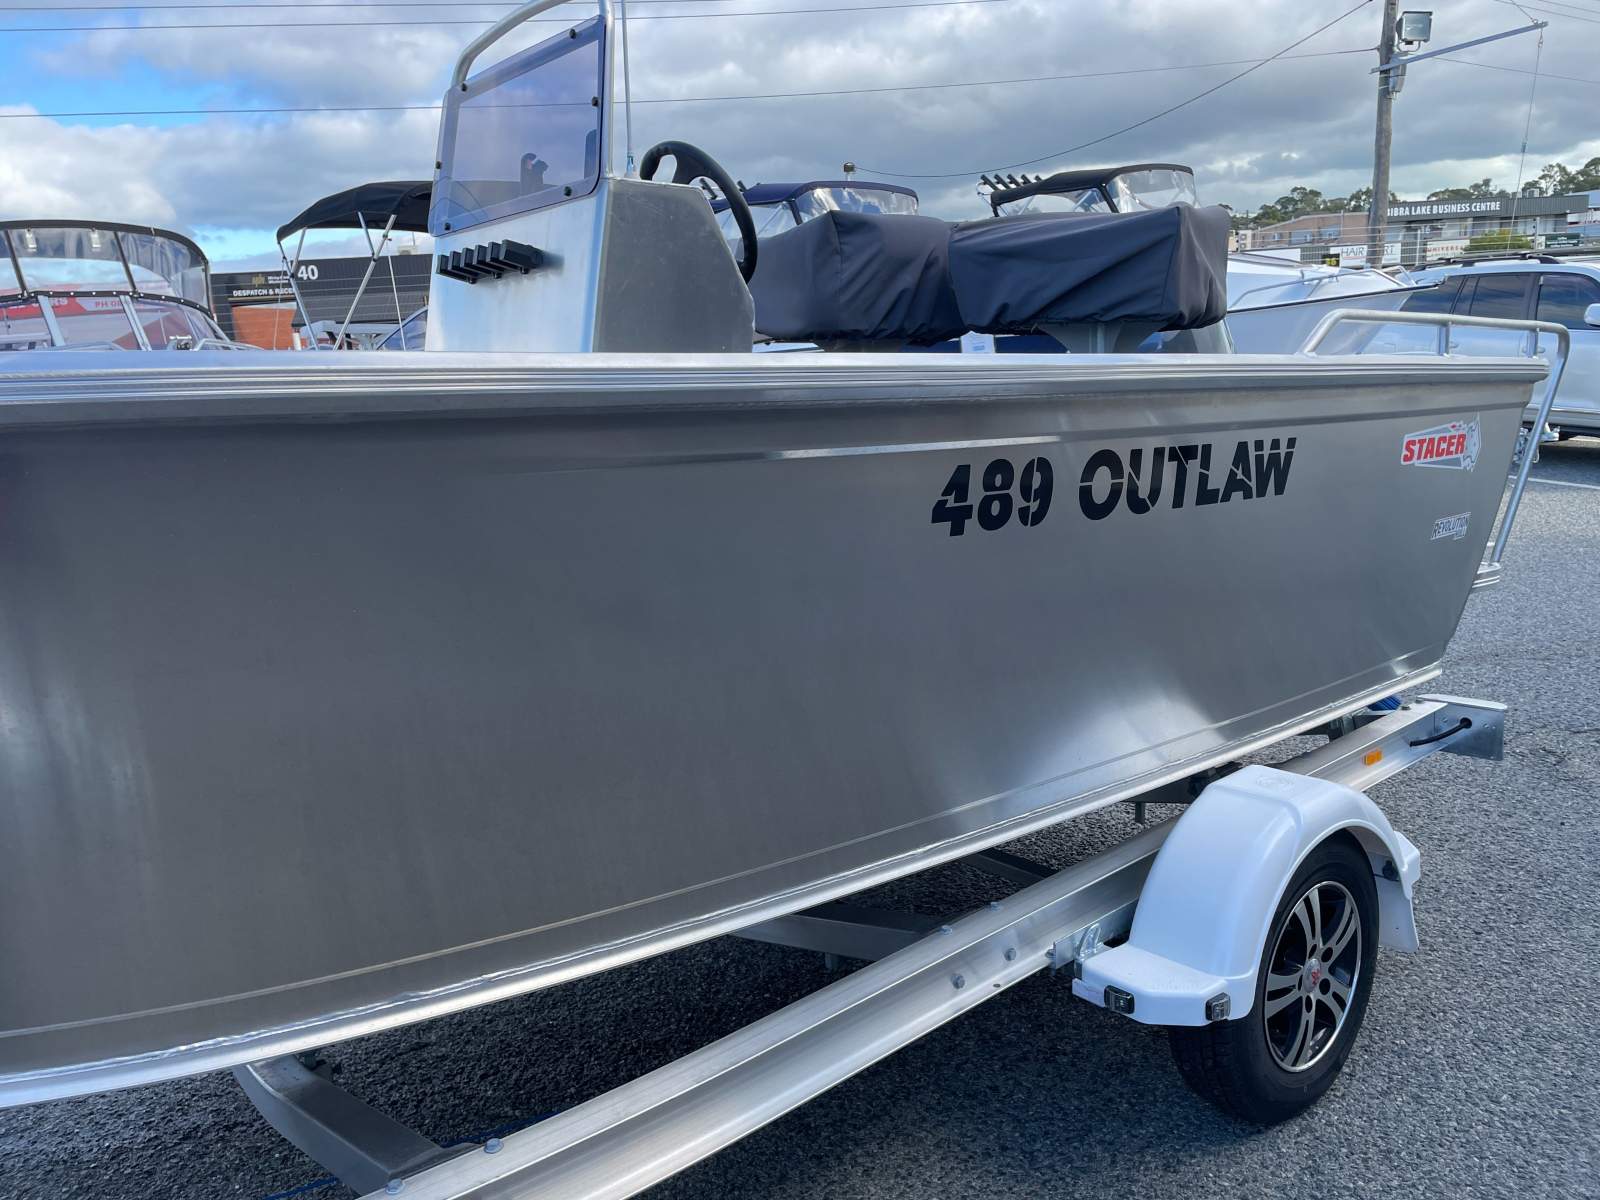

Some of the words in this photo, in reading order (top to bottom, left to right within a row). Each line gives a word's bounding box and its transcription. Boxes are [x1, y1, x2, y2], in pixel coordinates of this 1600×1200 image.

[1411, 205, 1431, 215] LAKE
[1432, 203, 1470, 214] BUSINESS
[1471, 201, 1501, 212] CENTRE
[1341, 247, 1364, 257] HAIR
[297, 264, 319, 281] 40
[232, 288, 268, 297] DESPATCH
[268, 288, 274, 296] &
[1403, 433, 1466, 462] STACER
[931, 456, 1054, 537] 489
[1078, 437, 1297, 521] OUTLAW
